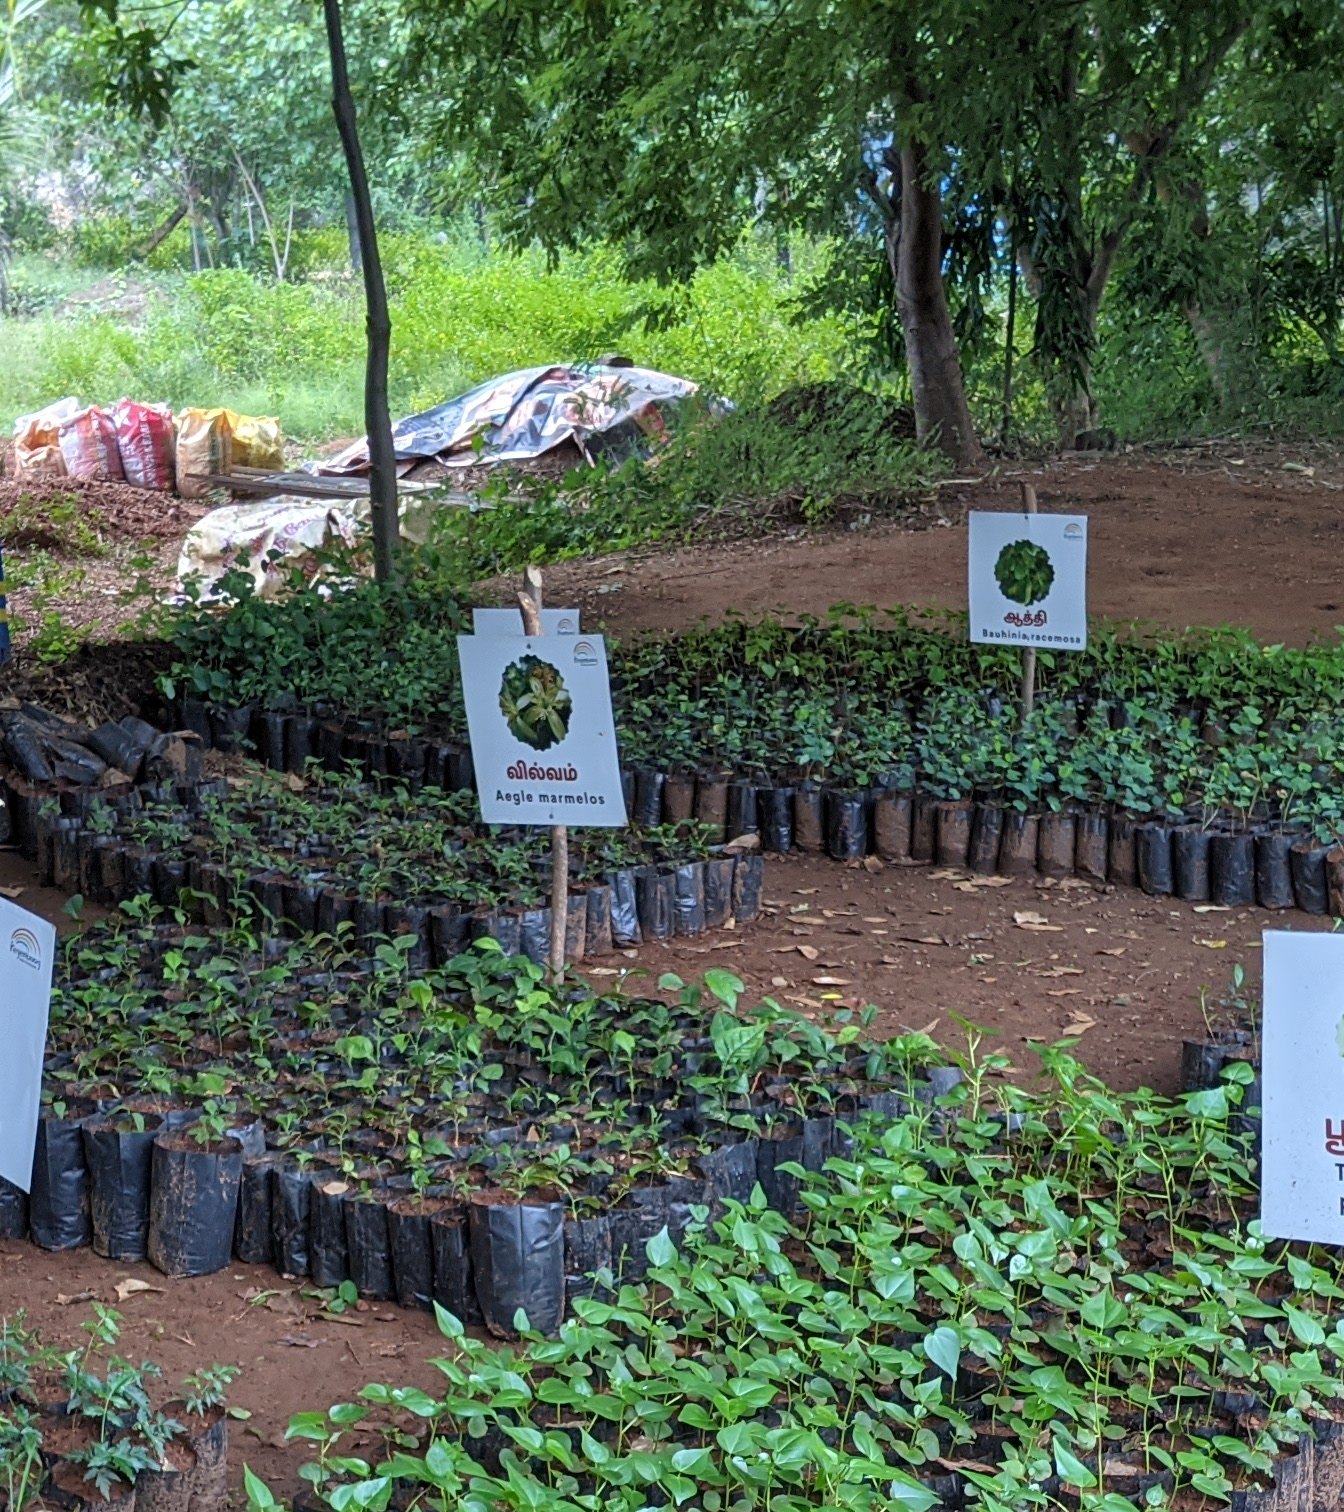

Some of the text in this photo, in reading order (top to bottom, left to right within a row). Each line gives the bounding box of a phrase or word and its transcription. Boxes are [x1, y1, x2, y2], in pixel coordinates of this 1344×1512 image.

[1004, 609, 1047, 627] ஆத்தி
[982, 628, 1081, 644] Bauhinia racemosa
[506, 760, 578, 781] வில்வம்
[496, 790, 605, 806] Aegle marmelos
